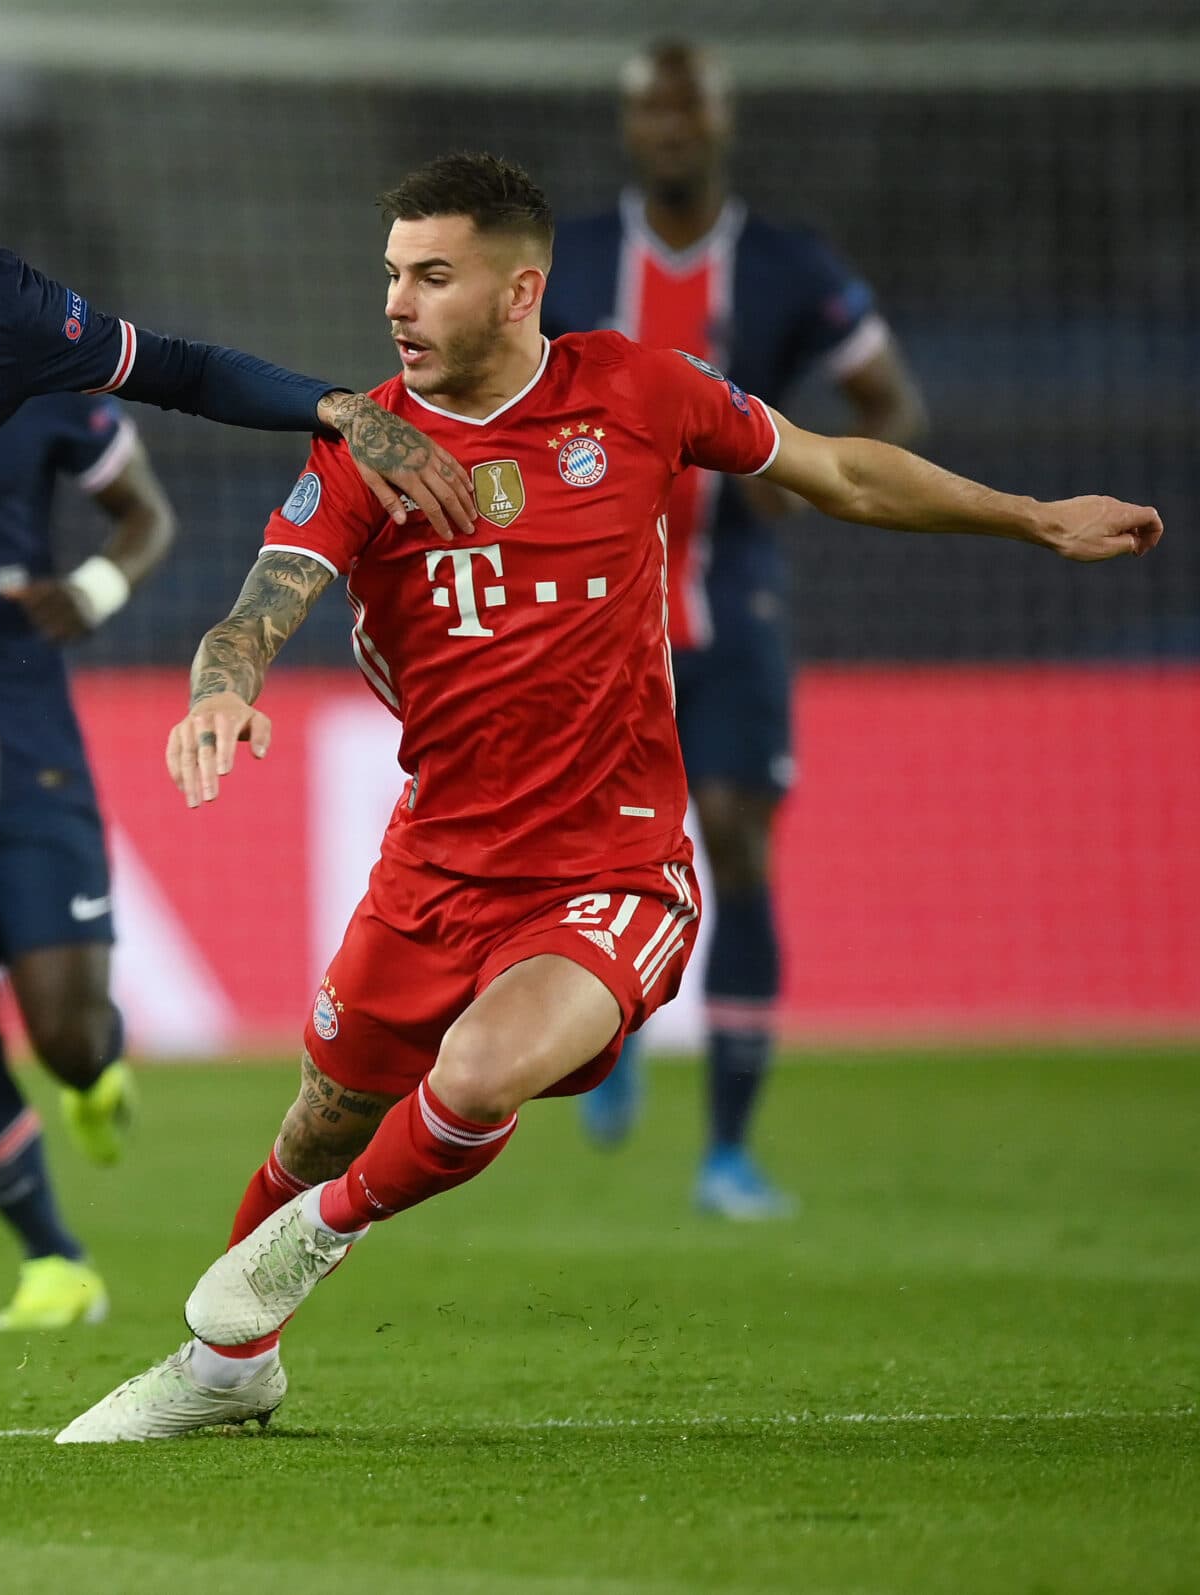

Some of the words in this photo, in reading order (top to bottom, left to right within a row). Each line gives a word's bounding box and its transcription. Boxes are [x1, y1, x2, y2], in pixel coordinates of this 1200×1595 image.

[71, 291, 82, 320] RES
[567, 440, 601, 457] BAYERN
[563, 463, 604, 485] MÜNCHEN
[490, 501, 513, 512] FIFA
[559, 893, 641, 937] 21
